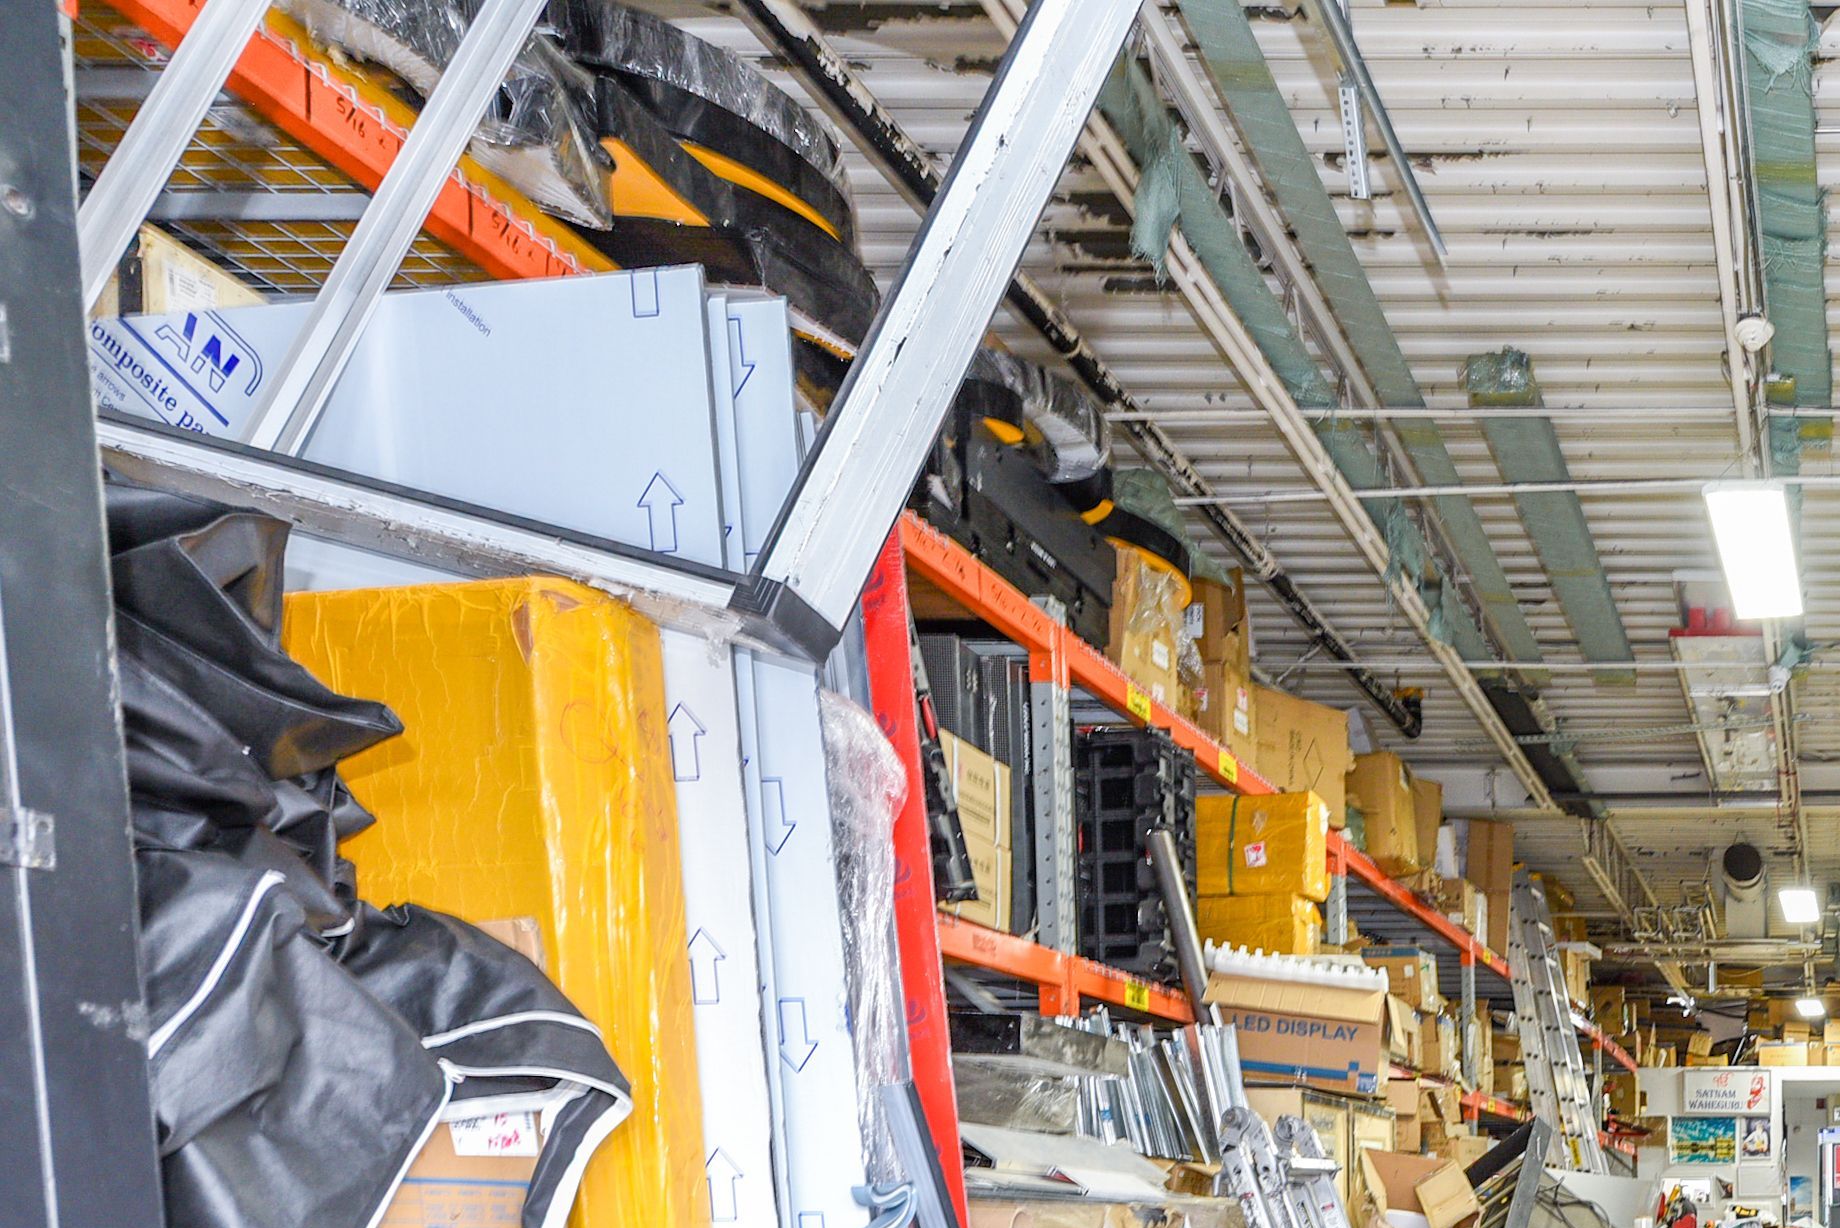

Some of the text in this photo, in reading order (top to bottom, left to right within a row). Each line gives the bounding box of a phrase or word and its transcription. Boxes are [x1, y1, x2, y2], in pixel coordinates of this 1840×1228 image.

[445, 292, 491, 337] installation
[1232, 1013, 1359, 1041] LED DISPLAY
[1695, 1088, 1736, 1099] SATNAM
